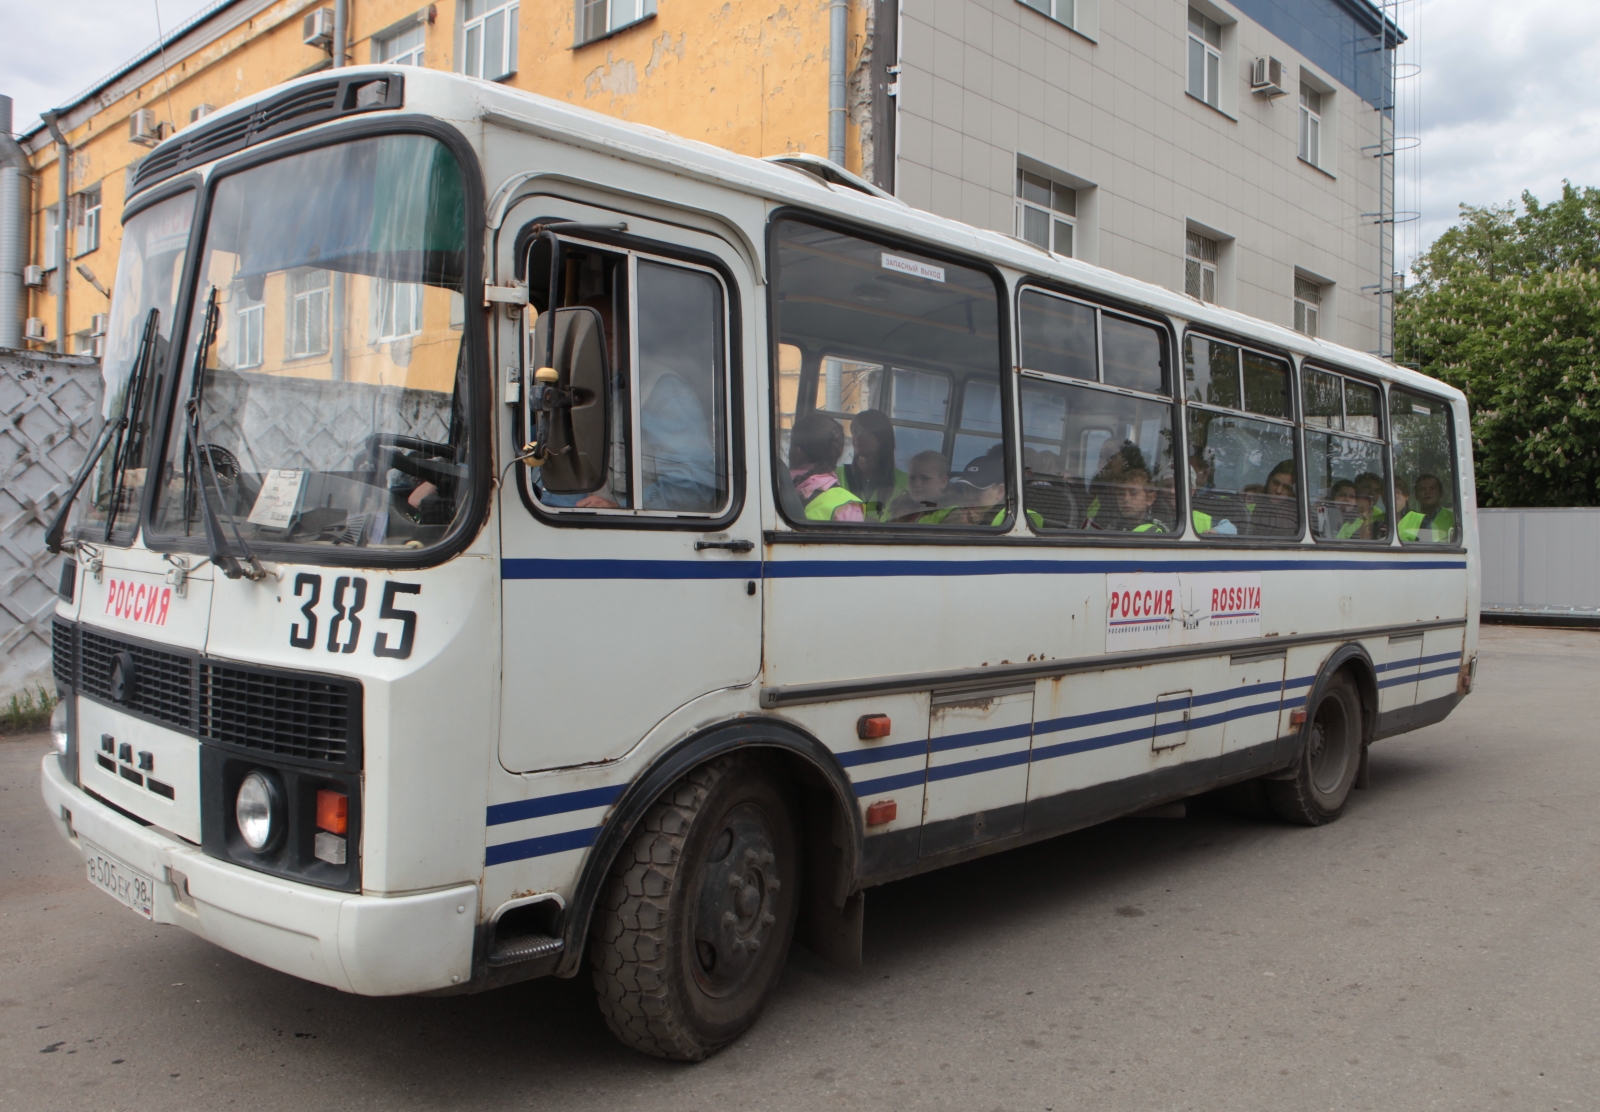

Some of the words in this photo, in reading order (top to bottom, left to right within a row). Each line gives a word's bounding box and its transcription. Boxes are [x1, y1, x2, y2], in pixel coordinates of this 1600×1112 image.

[885, 258, 919, 273] ЗАПАСНЫЙ
[920, 268, 942, 280] ВЫХОД
[105, 579, 171, 626] РОССИЯ
[1109, 589, 1174, 618] РОССИЯ
[1211, 587, 1261, 612] ROSSIYA
[289, 572, 422, 660] 385
[101, 733, 154, 771] ПАЗ
[134, 877, 147, 902] 98
